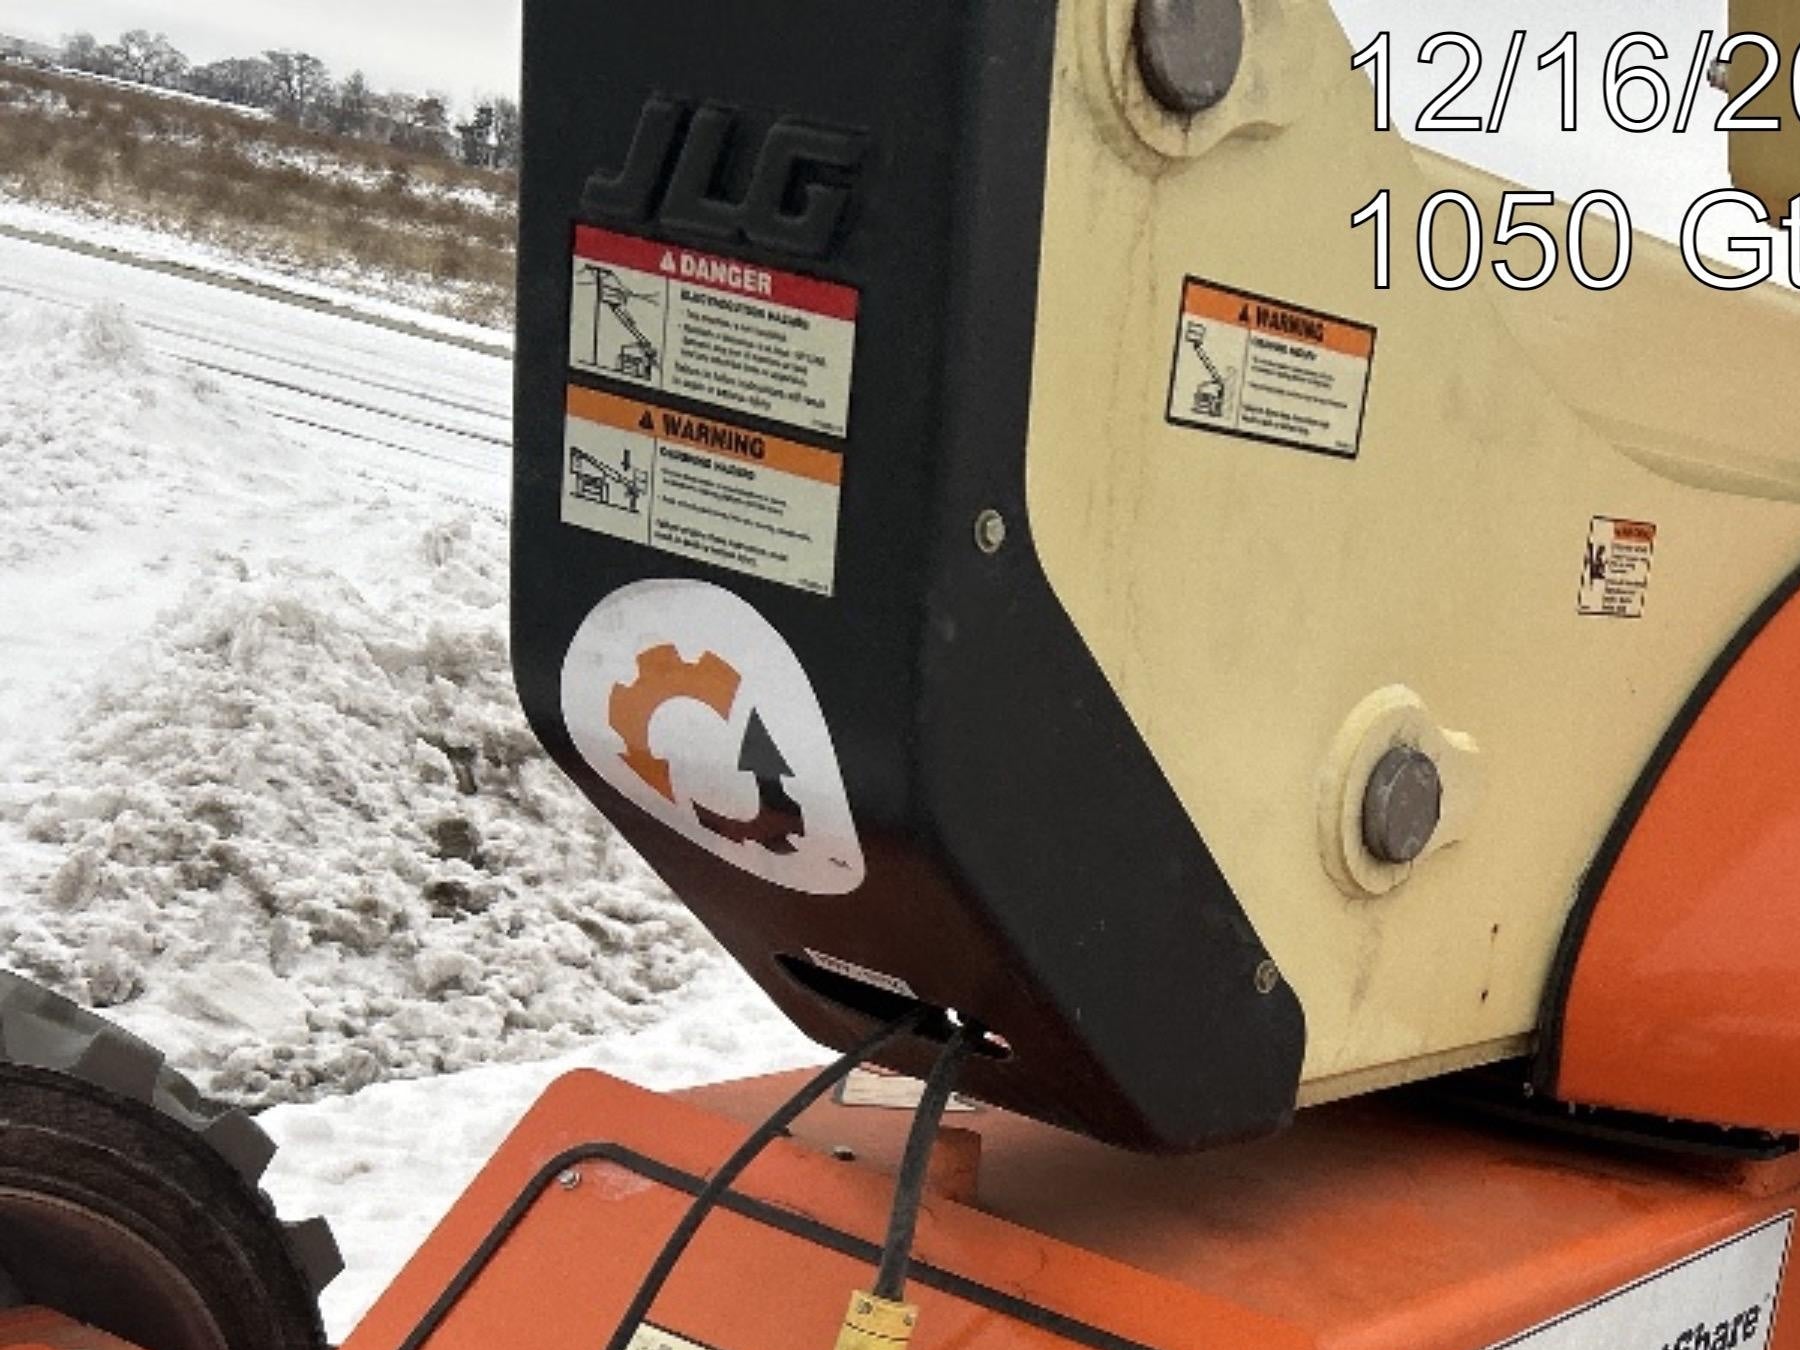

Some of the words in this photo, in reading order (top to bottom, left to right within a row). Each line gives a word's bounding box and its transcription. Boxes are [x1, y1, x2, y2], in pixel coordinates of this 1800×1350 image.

[578, 94, 870, 258] JLG
[680, 254, 772, 296] DANGER
[662, 413, 766, 460] WARNING
